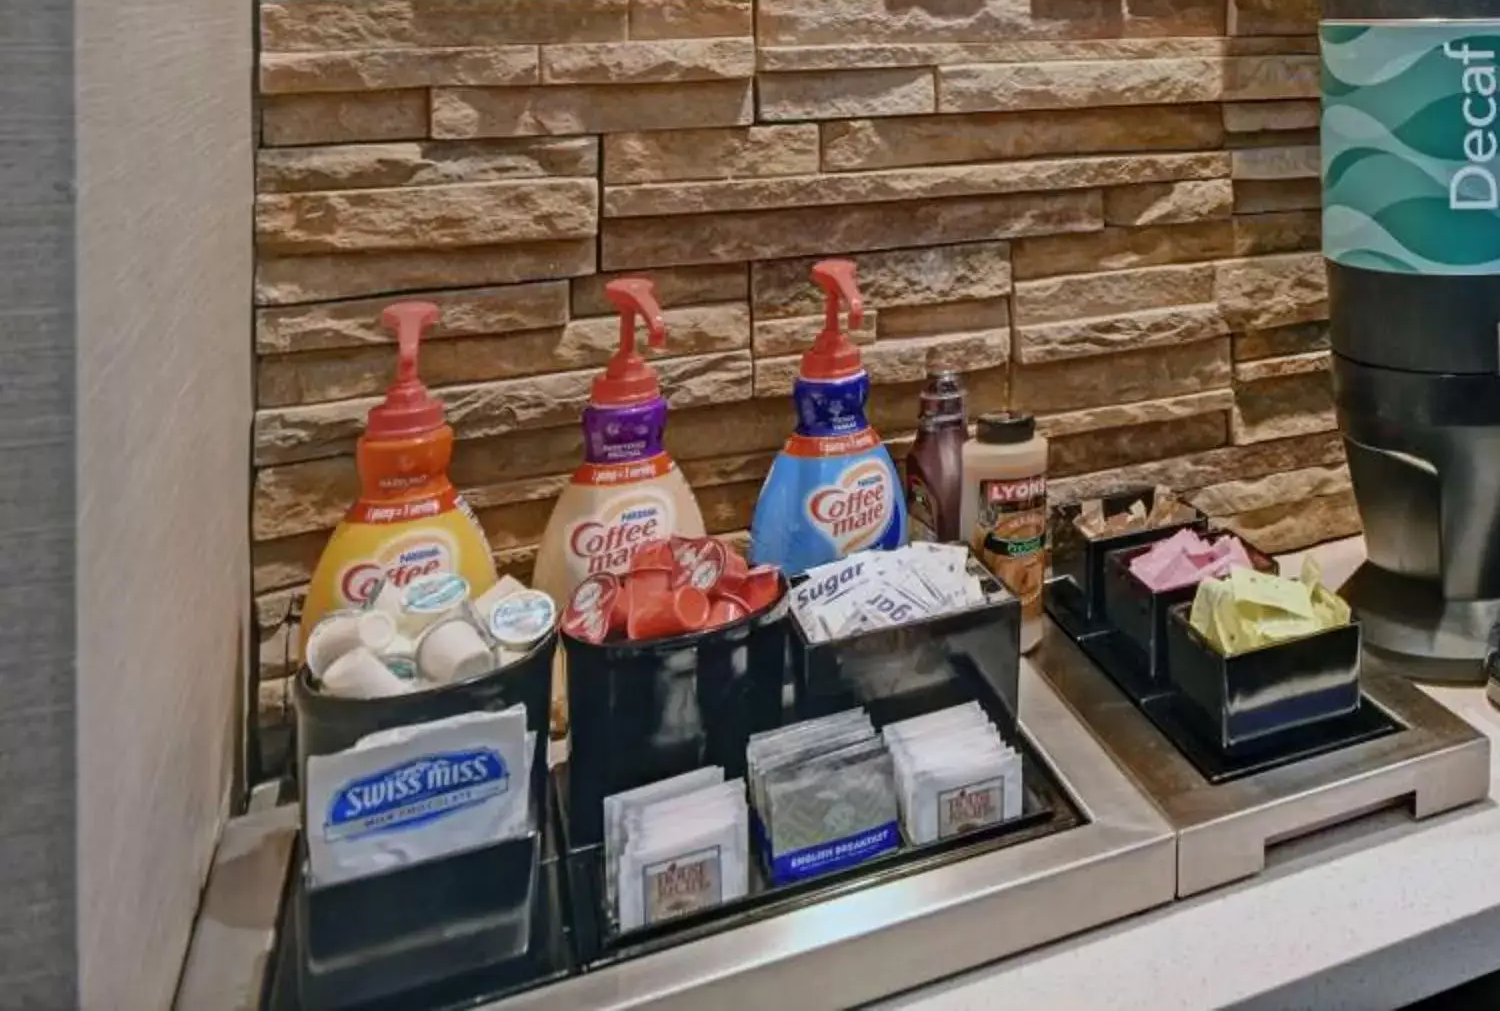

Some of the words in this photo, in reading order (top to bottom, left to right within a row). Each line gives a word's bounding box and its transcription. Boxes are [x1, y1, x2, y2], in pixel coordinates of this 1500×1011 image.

[1443, 42, 1499, 210] Decaf
[810, 484, 885, 524] Coffee
[832, 500, 884, 538] mate
[570, 517, 658, 558] Coffee
[796, 561, 865, 610] Sugar
